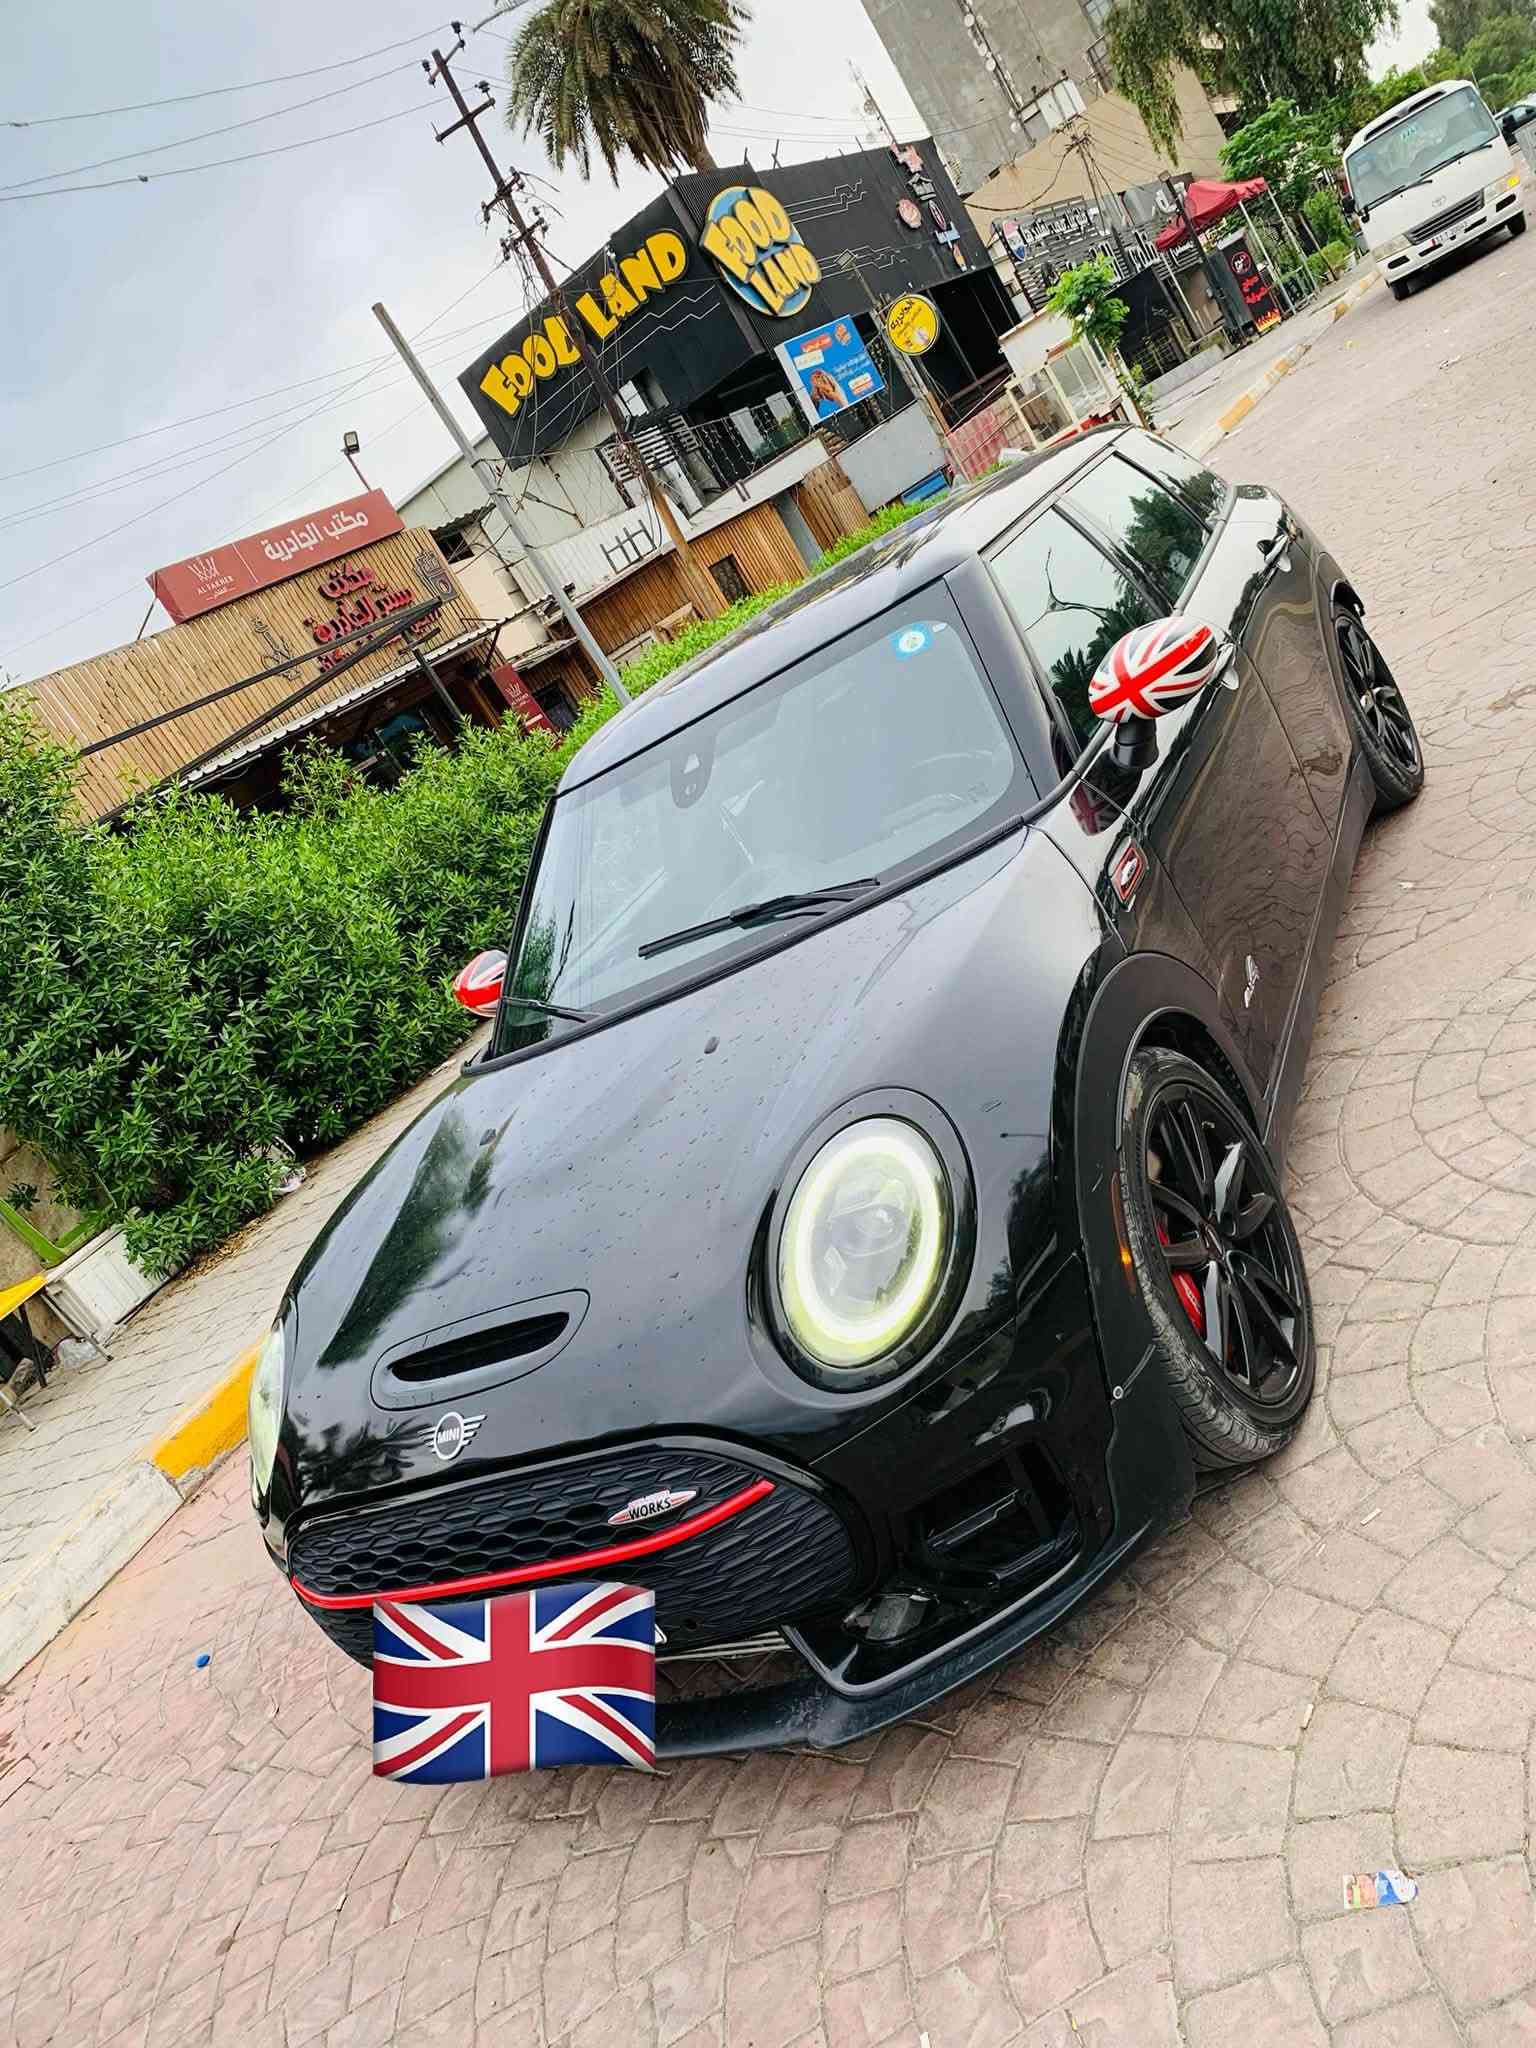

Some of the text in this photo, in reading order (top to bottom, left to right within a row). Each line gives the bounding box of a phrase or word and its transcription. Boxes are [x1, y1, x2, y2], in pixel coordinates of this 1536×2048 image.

[702, 187, 791, 283] FOOD
[575, 231, 687, 339] LAND
[750, 244, 821, 315] LAND
[260, 511, 369, 561] مكتب الجادرية
[437, 1427, 460, 1444] MINI
[629, 1497, 672, 1521] WORKS
